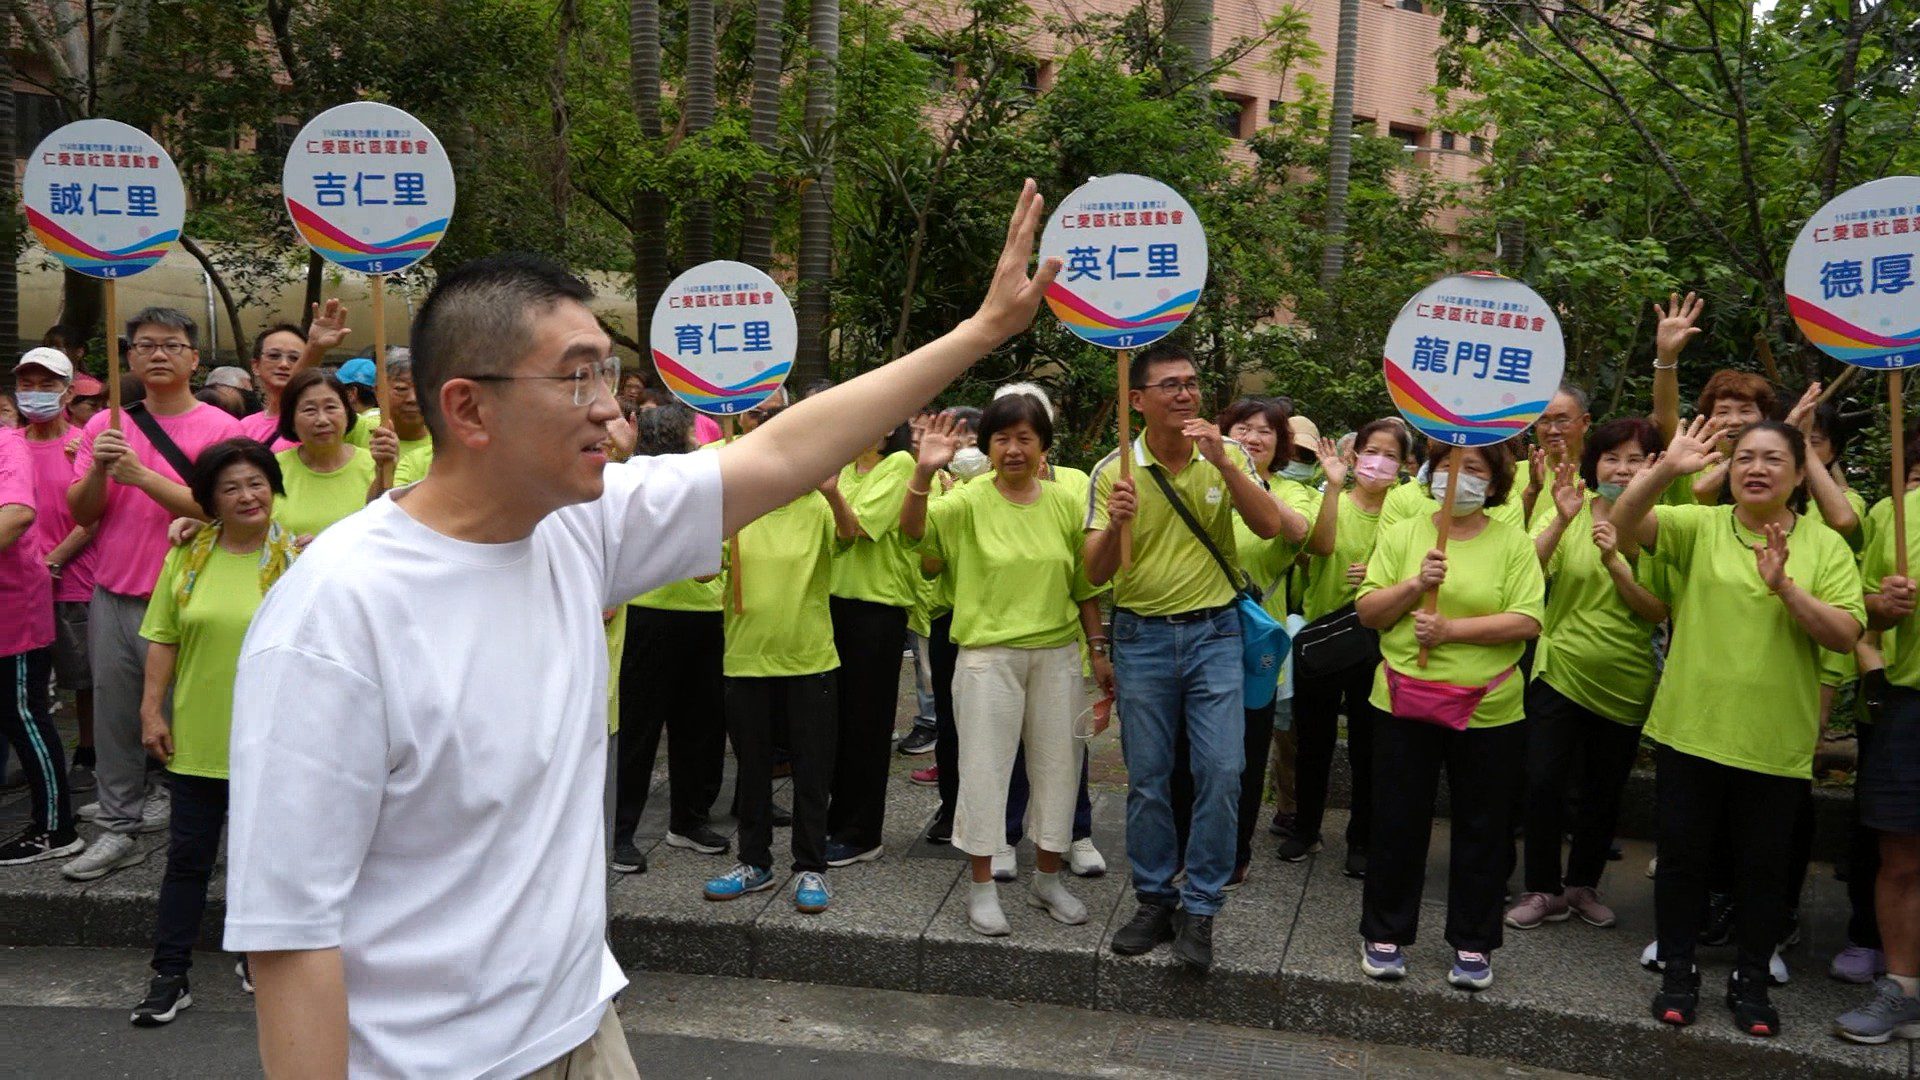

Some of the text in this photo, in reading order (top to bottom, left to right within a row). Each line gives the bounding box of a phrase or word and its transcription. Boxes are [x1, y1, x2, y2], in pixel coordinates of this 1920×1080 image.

[306, 140, 428, 154] 仁愛區社區運動會
[43, 152, 159, 168] 仁愛區社區運動會
[312, 171, 428, 206] 吉仁里
[49, 183, 160, 216] 誠仁里
[1061, 210, 1184, 229] 仁愛區社區運動會
[367, 262, 383, 271] 15
[1067, 243, 1181, 282] 英仁里
[102, 267, 117, 276] 14
[1819, 253, 1915, 300] 德厚
[669, 291, 774, 308] 仁愛區社區運動會
[1416, 303, 1547, 332] 仁愛區社區運動會
[674, 320, 773, 356] 育仁里
[1118, 336, 1134, 346] 17
[1412, 335, 1532, 385] 龍門里
[1884, 355, 1904, 367] 19
[720, 403, 734, 413] 16
[1451, 432, 1467, 444] 18
